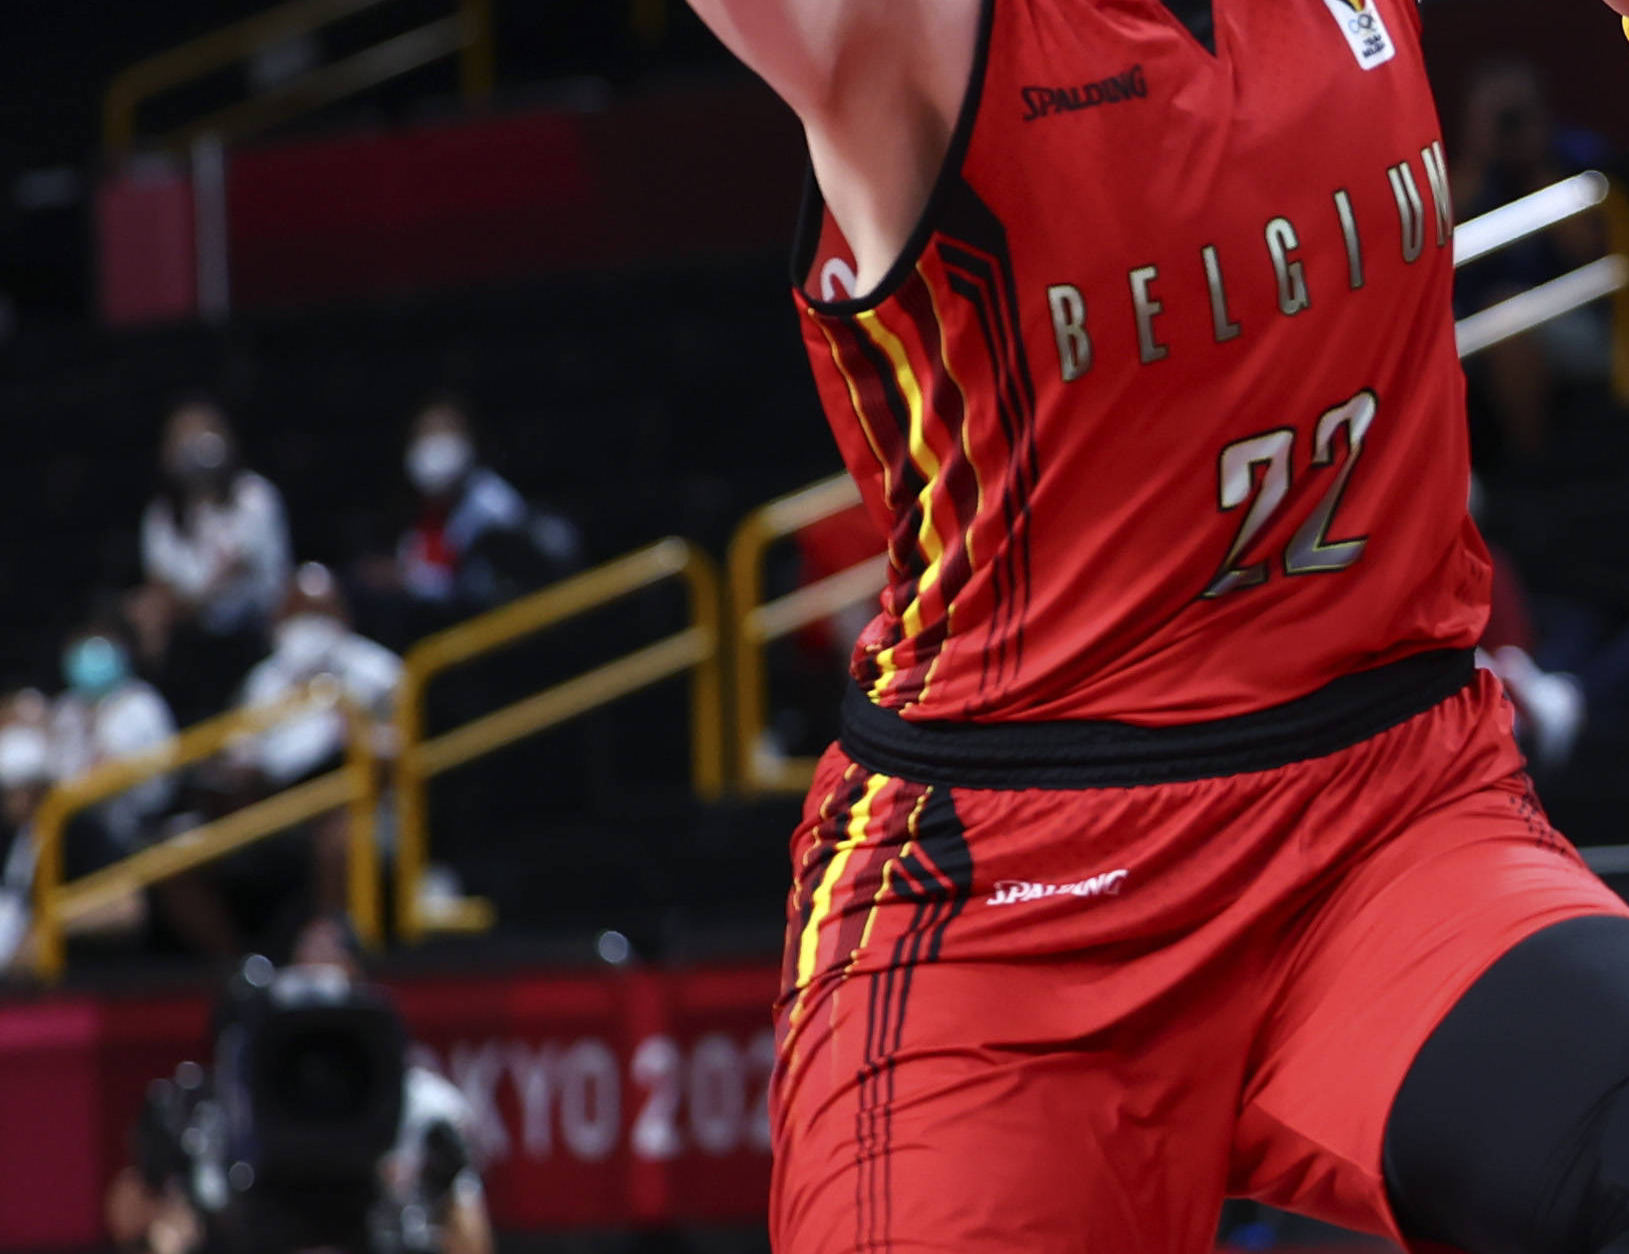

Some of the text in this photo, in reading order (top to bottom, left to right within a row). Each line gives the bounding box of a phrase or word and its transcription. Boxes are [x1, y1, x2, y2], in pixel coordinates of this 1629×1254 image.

[1021, 63, 1148, 122] SPALDING
[1199, 387, 1379, 600] 22
[405, 1034, 774, 1160] KYO 202
